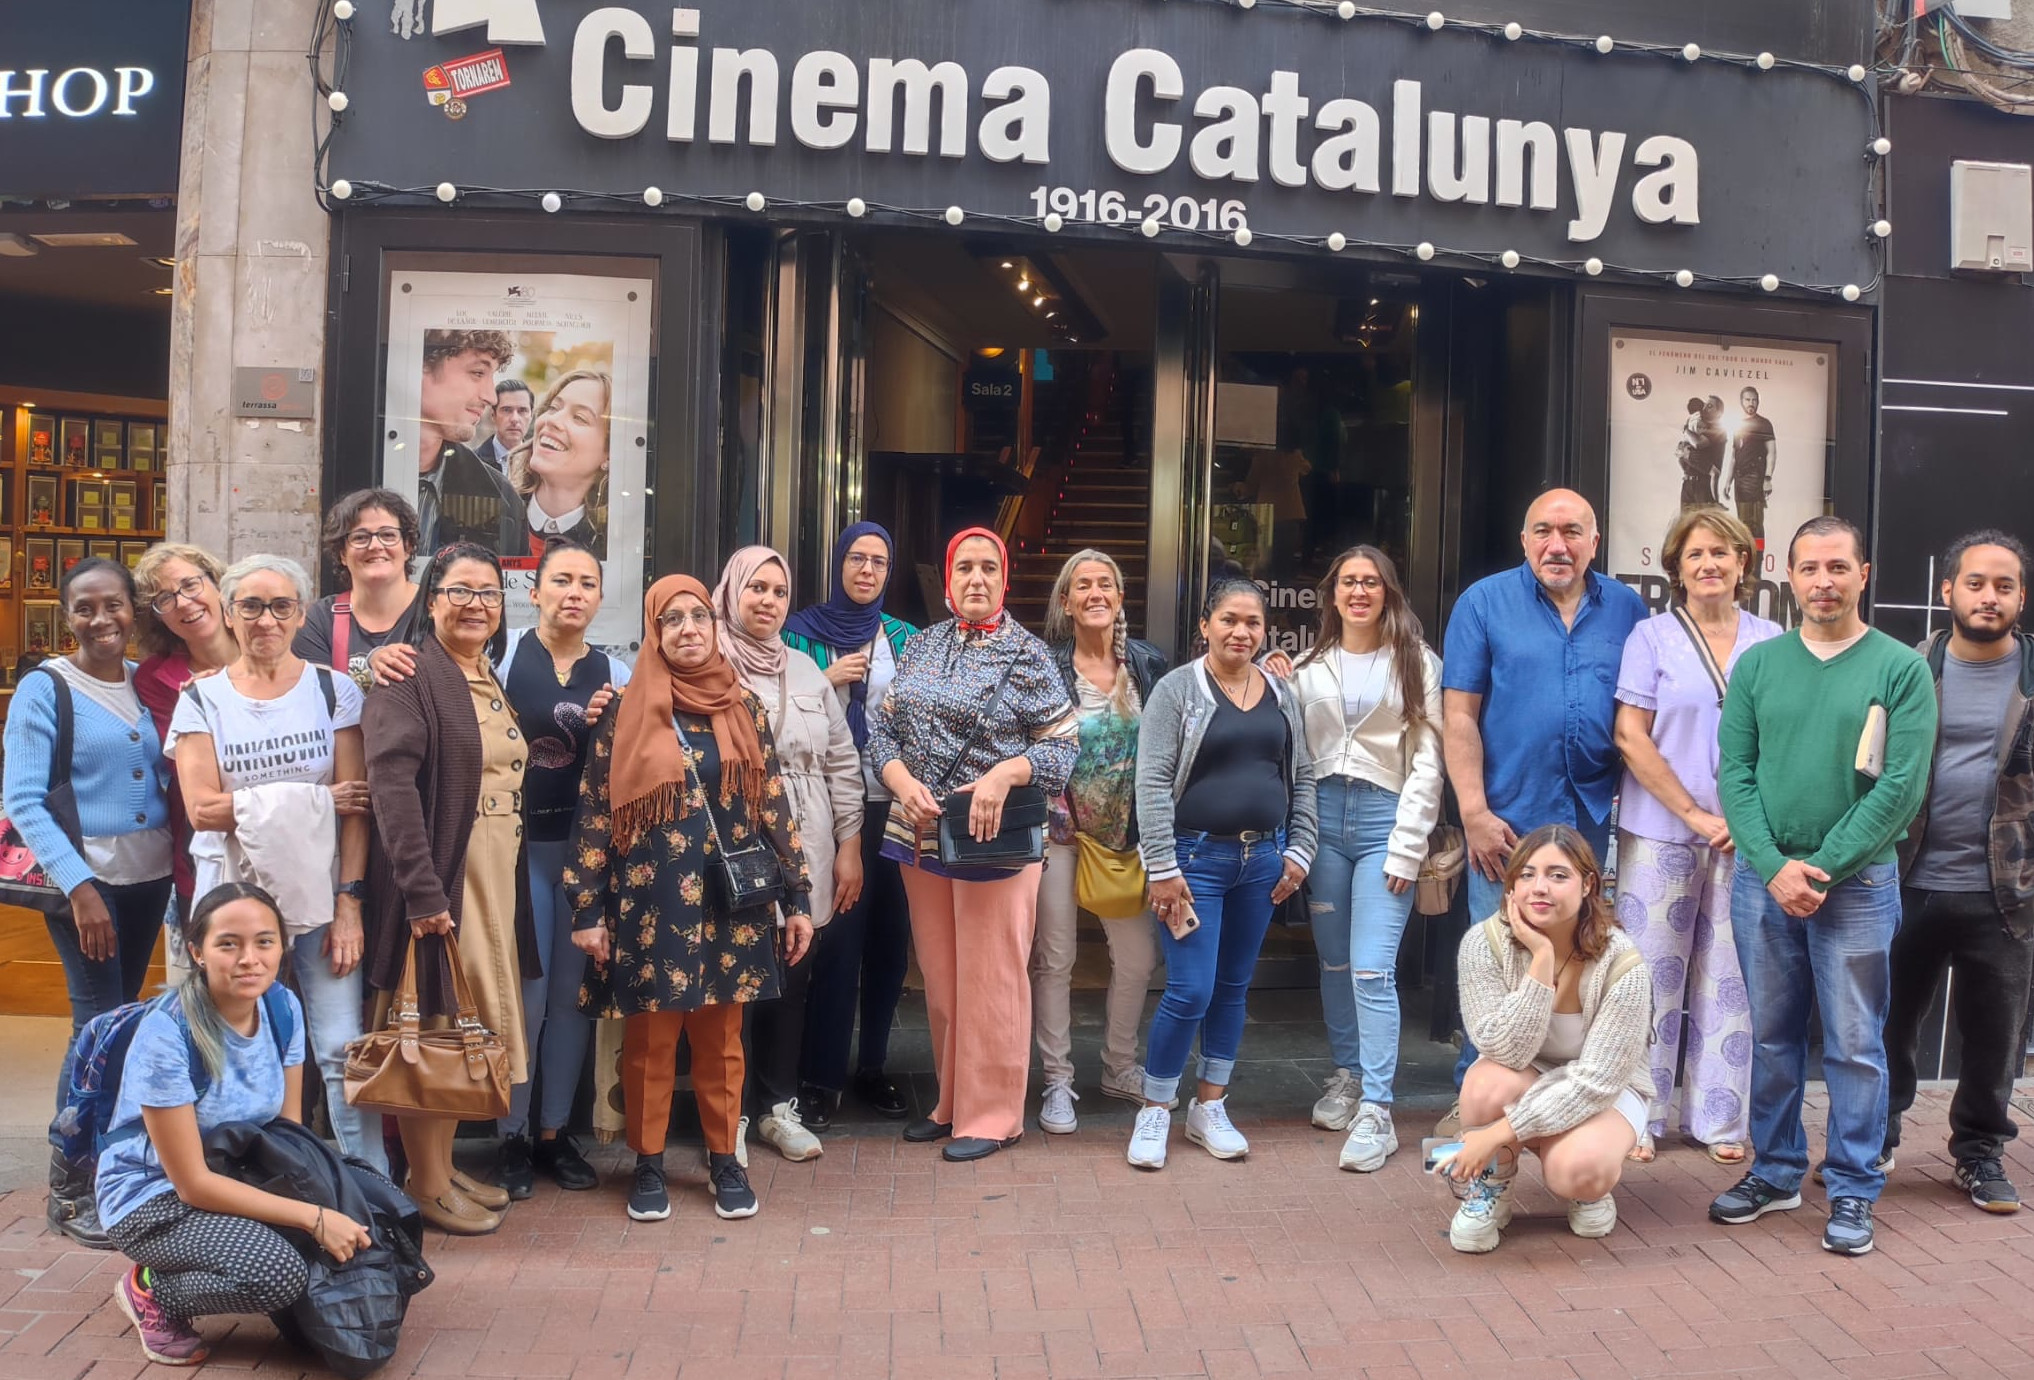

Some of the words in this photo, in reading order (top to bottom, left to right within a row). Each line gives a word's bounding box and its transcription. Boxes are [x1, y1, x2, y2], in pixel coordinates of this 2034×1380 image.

[450, 57, 504, 92] TORNAREM
[571, 7, 1050, 164] Cinema
[1105, 48, 1700, 242] Catalunya
[1030, 185, 1248, 232] 1916-2016
[1676, 365, 1696, 375] JIM
[1706, 367, 1769, 380] CAVIEZEL
[972, 382, 1002, 396] Sala
[1003, 384, 1013, 396] 2
[242, 400, 277, 409] terrassa
[244, 764, 311, 782] SOMETHING
